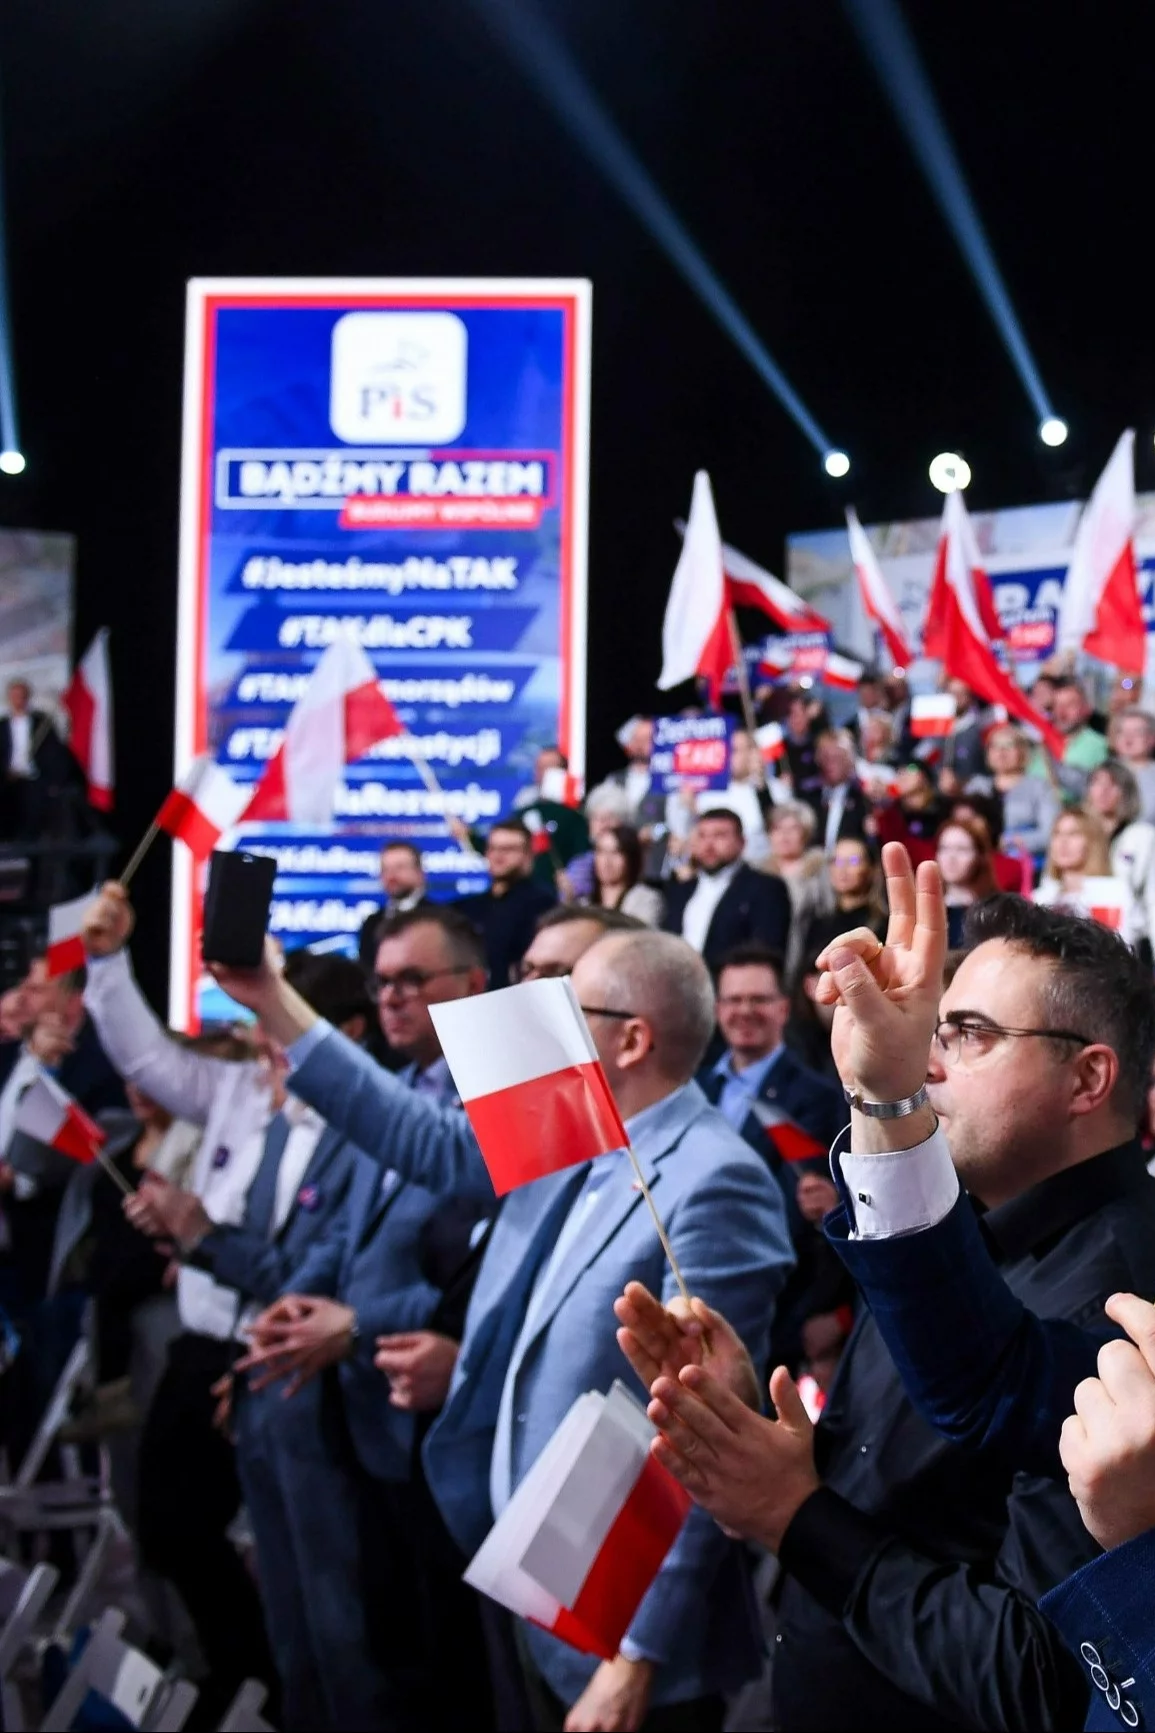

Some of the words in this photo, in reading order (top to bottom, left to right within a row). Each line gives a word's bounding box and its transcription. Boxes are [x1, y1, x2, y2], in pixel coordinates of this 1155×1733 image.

[358, 383, 438, 420] PiS
[239, 453, 406, 503] BĄDŹMY
[408, 461, 544, 496] RAZEM
[242, 555, 518, 597] #JesteśmyNaTAK
